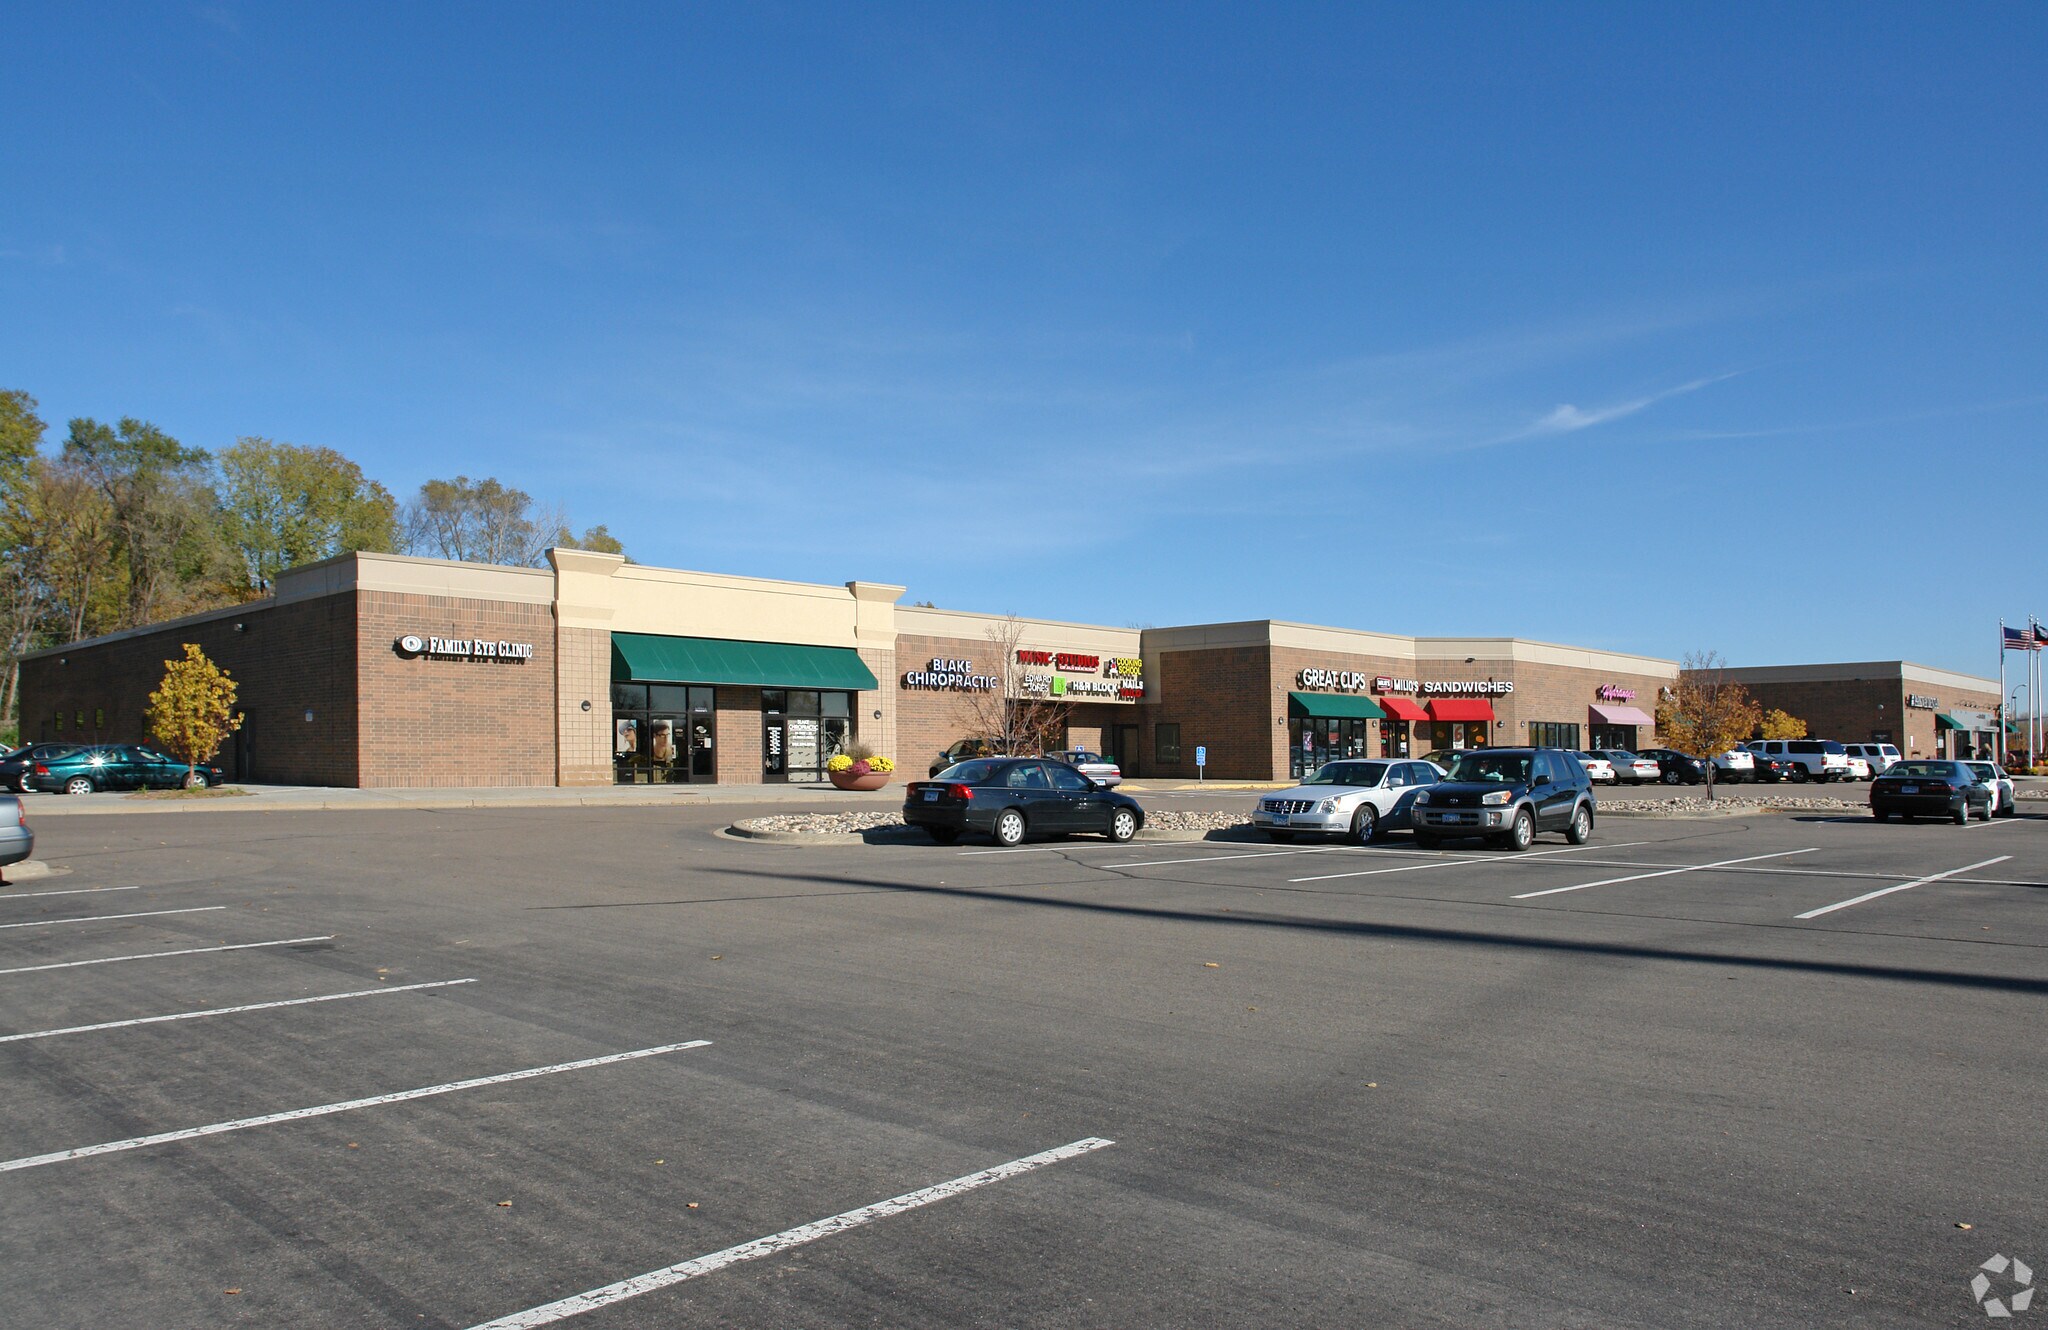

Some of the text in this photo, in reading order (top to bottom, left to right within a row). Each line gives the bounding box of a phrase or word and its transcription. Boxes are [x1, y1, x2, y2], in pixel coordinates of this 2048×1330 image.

[429, 636, 533, 658] FAMILY EYE CLINIC
[1019, 650, 1100, 667] MUSIC STUDIOS
[1116, 657, 1142, 667] COOKING
[933, 658, 972, 673] BLAKE
[1118, 665, 1141, 675] SCHOOL
[906, 671, 997, 688] CHIROPRACTIC
[1025, 674, 1051, 683] EDWARD
[1303, 668, 1337, 688] GREAT
[1340, 671, 1365, 689] CLIPS
[1027, 683, 1049, 692] JONES
[1073, 681, 1118, 692] H&R BLOCK
[1122, 680, 1143, 689] NAILS
[1424, 681, 1513, 693] SANDWICHES
